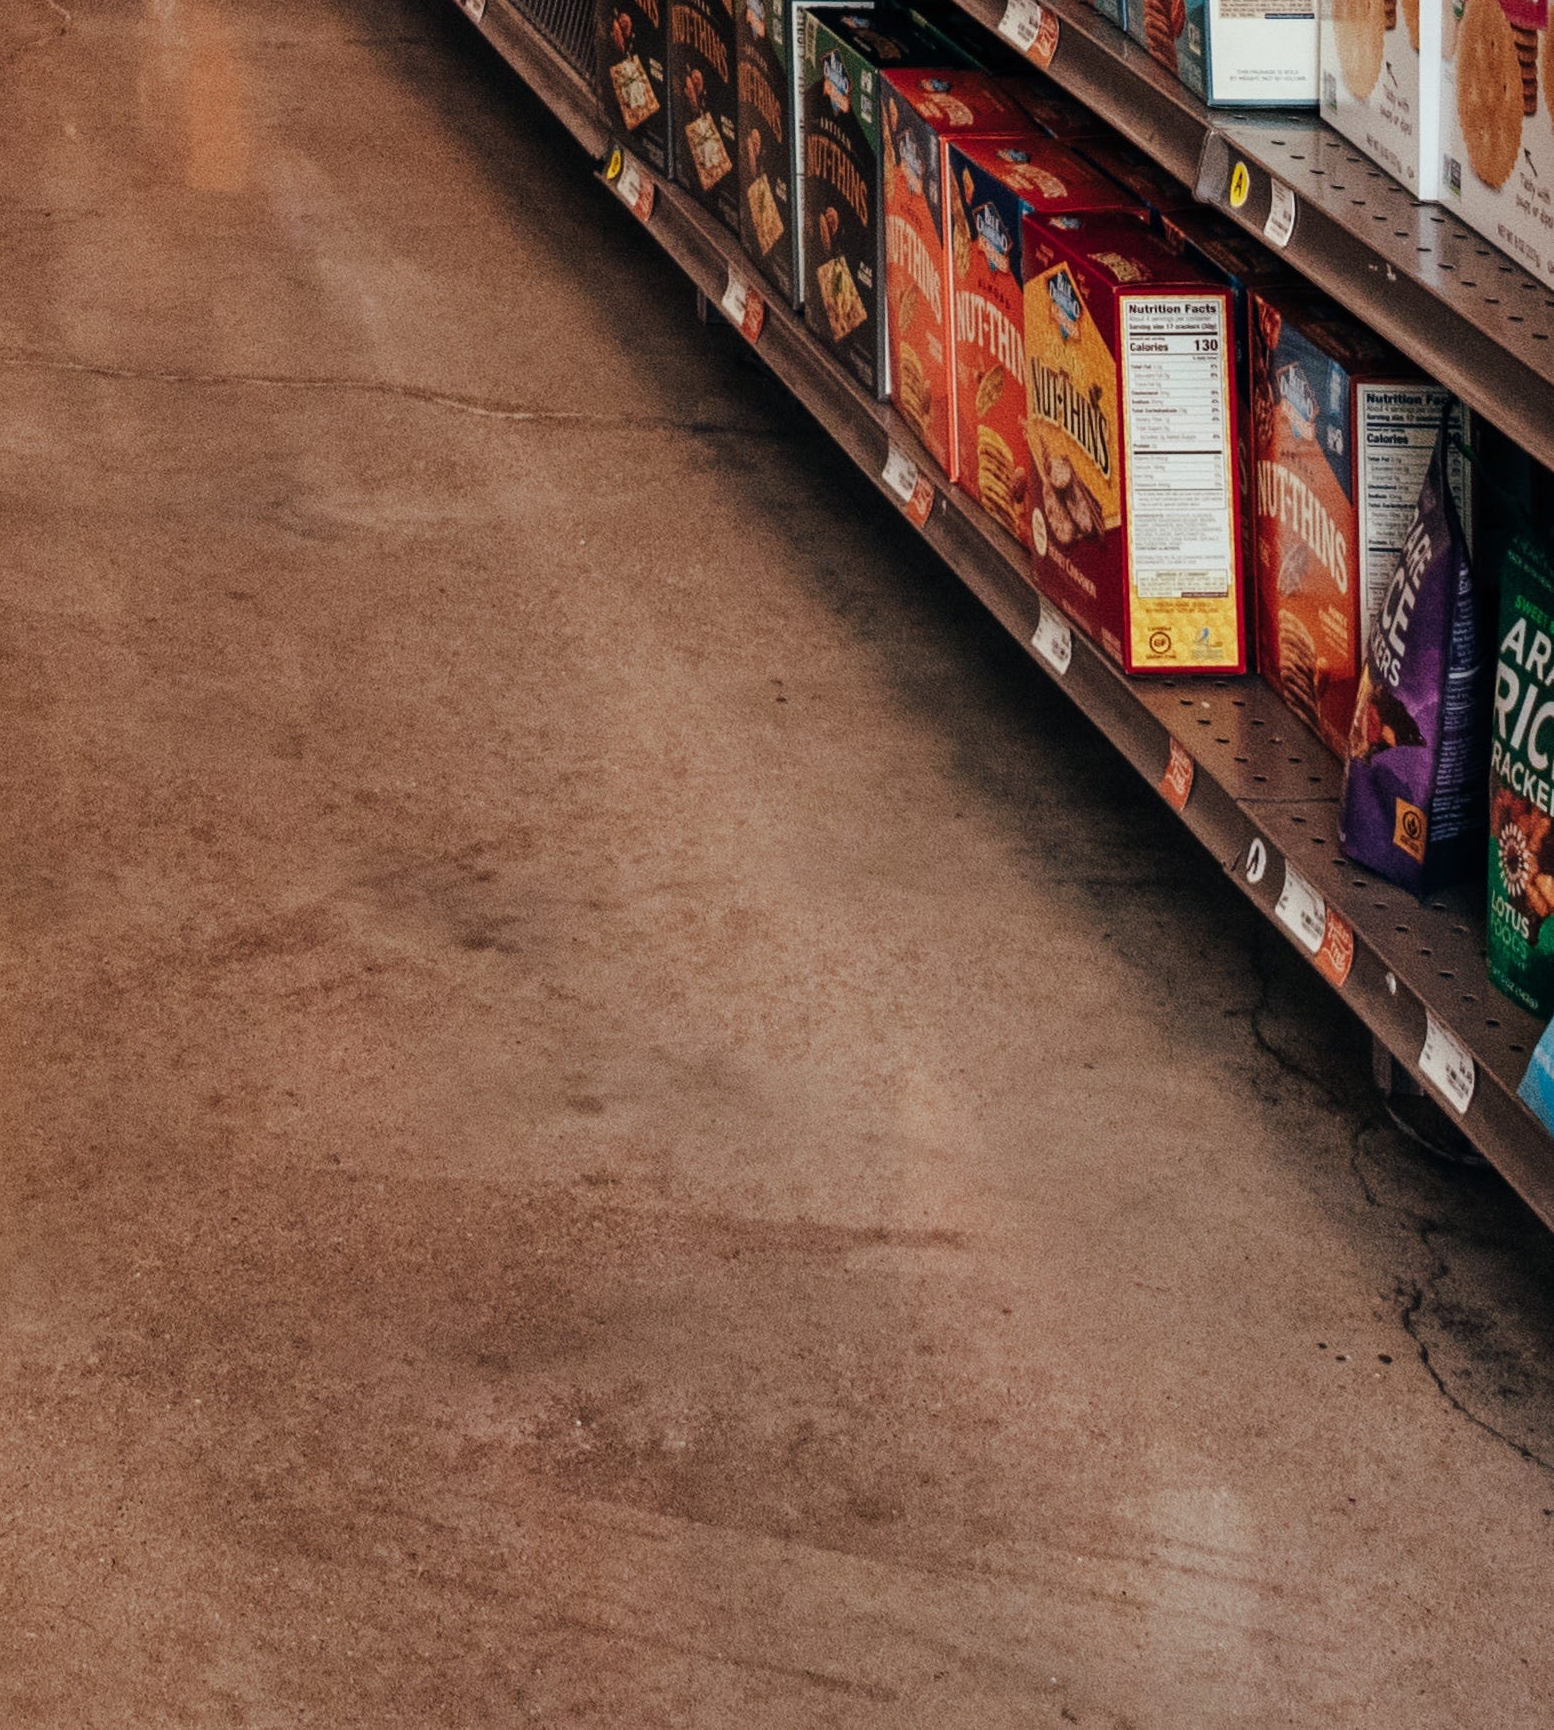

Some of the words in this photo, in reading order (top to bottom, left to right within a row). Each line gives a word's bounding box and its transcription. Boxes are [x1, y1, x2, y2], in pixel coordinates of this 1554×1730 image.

[1128, 303, 1182, 316] Nutrition
[1184, 303, 1218, 316] Facts
[1129, 341, 1170, 353] Calories
[1193, 339, 1219, 352] 130
[1257, 461, 1348, 595] NUT-THINS
